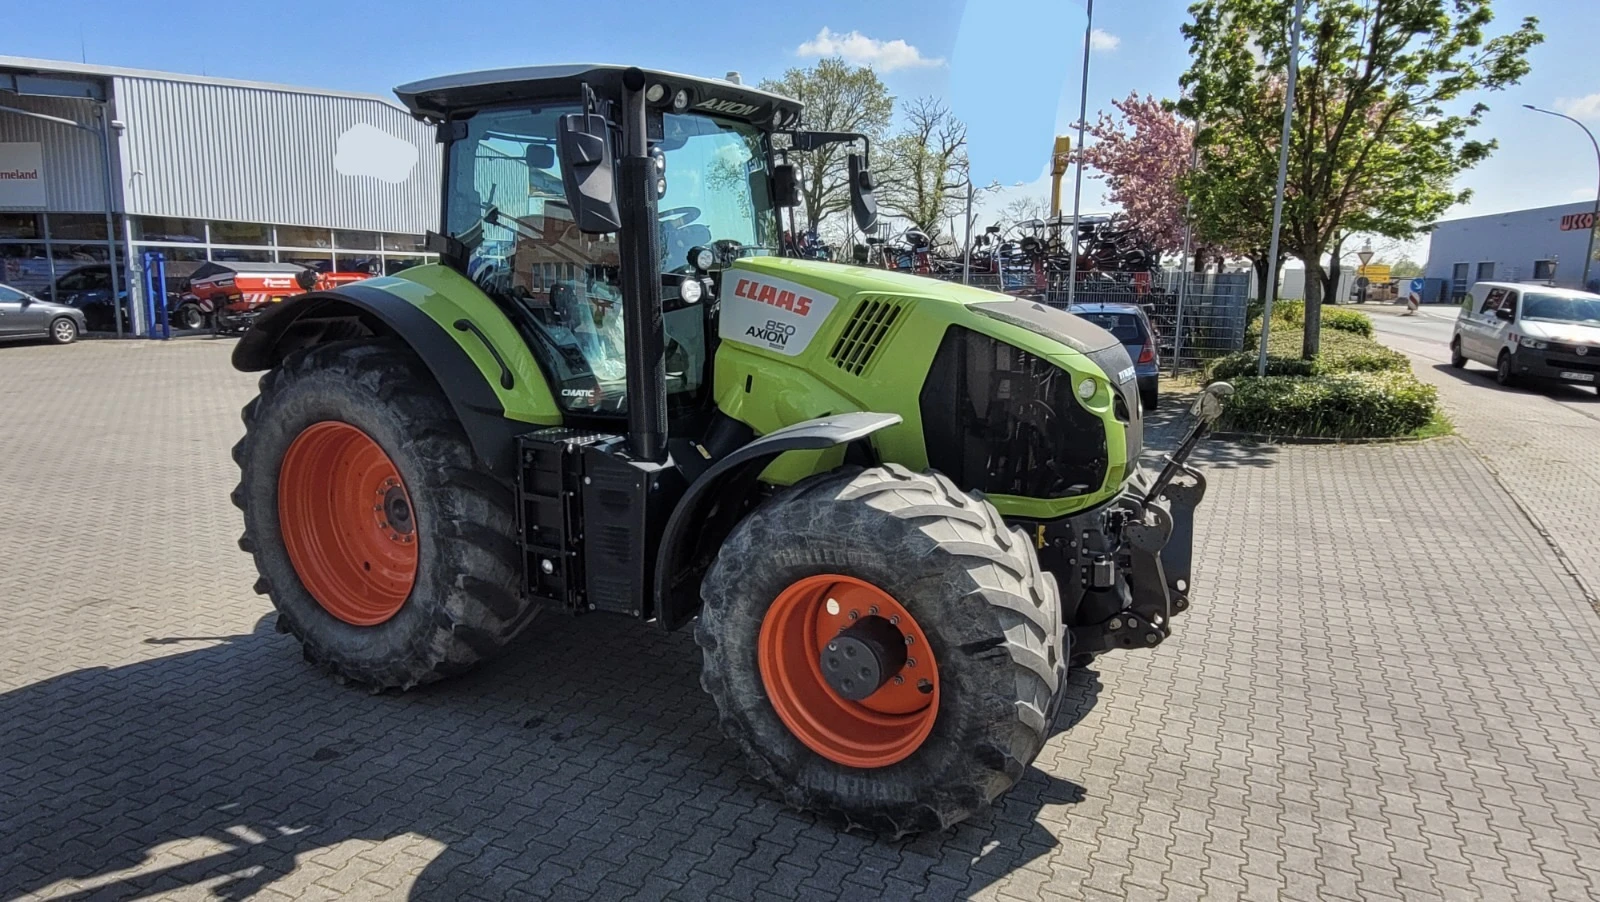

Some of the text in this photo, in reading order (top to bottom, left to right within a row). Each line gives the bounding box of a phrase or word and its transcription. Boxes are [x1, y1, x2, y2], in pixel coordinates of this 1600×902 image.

[696, 97, 760, 116] AXION
[734, 278, 813, 317] CLAAS
[745, 325, 789, 345] AXION
[765, 319, 796, 336] 850
[561, 388, 596, 397] CMATIC
